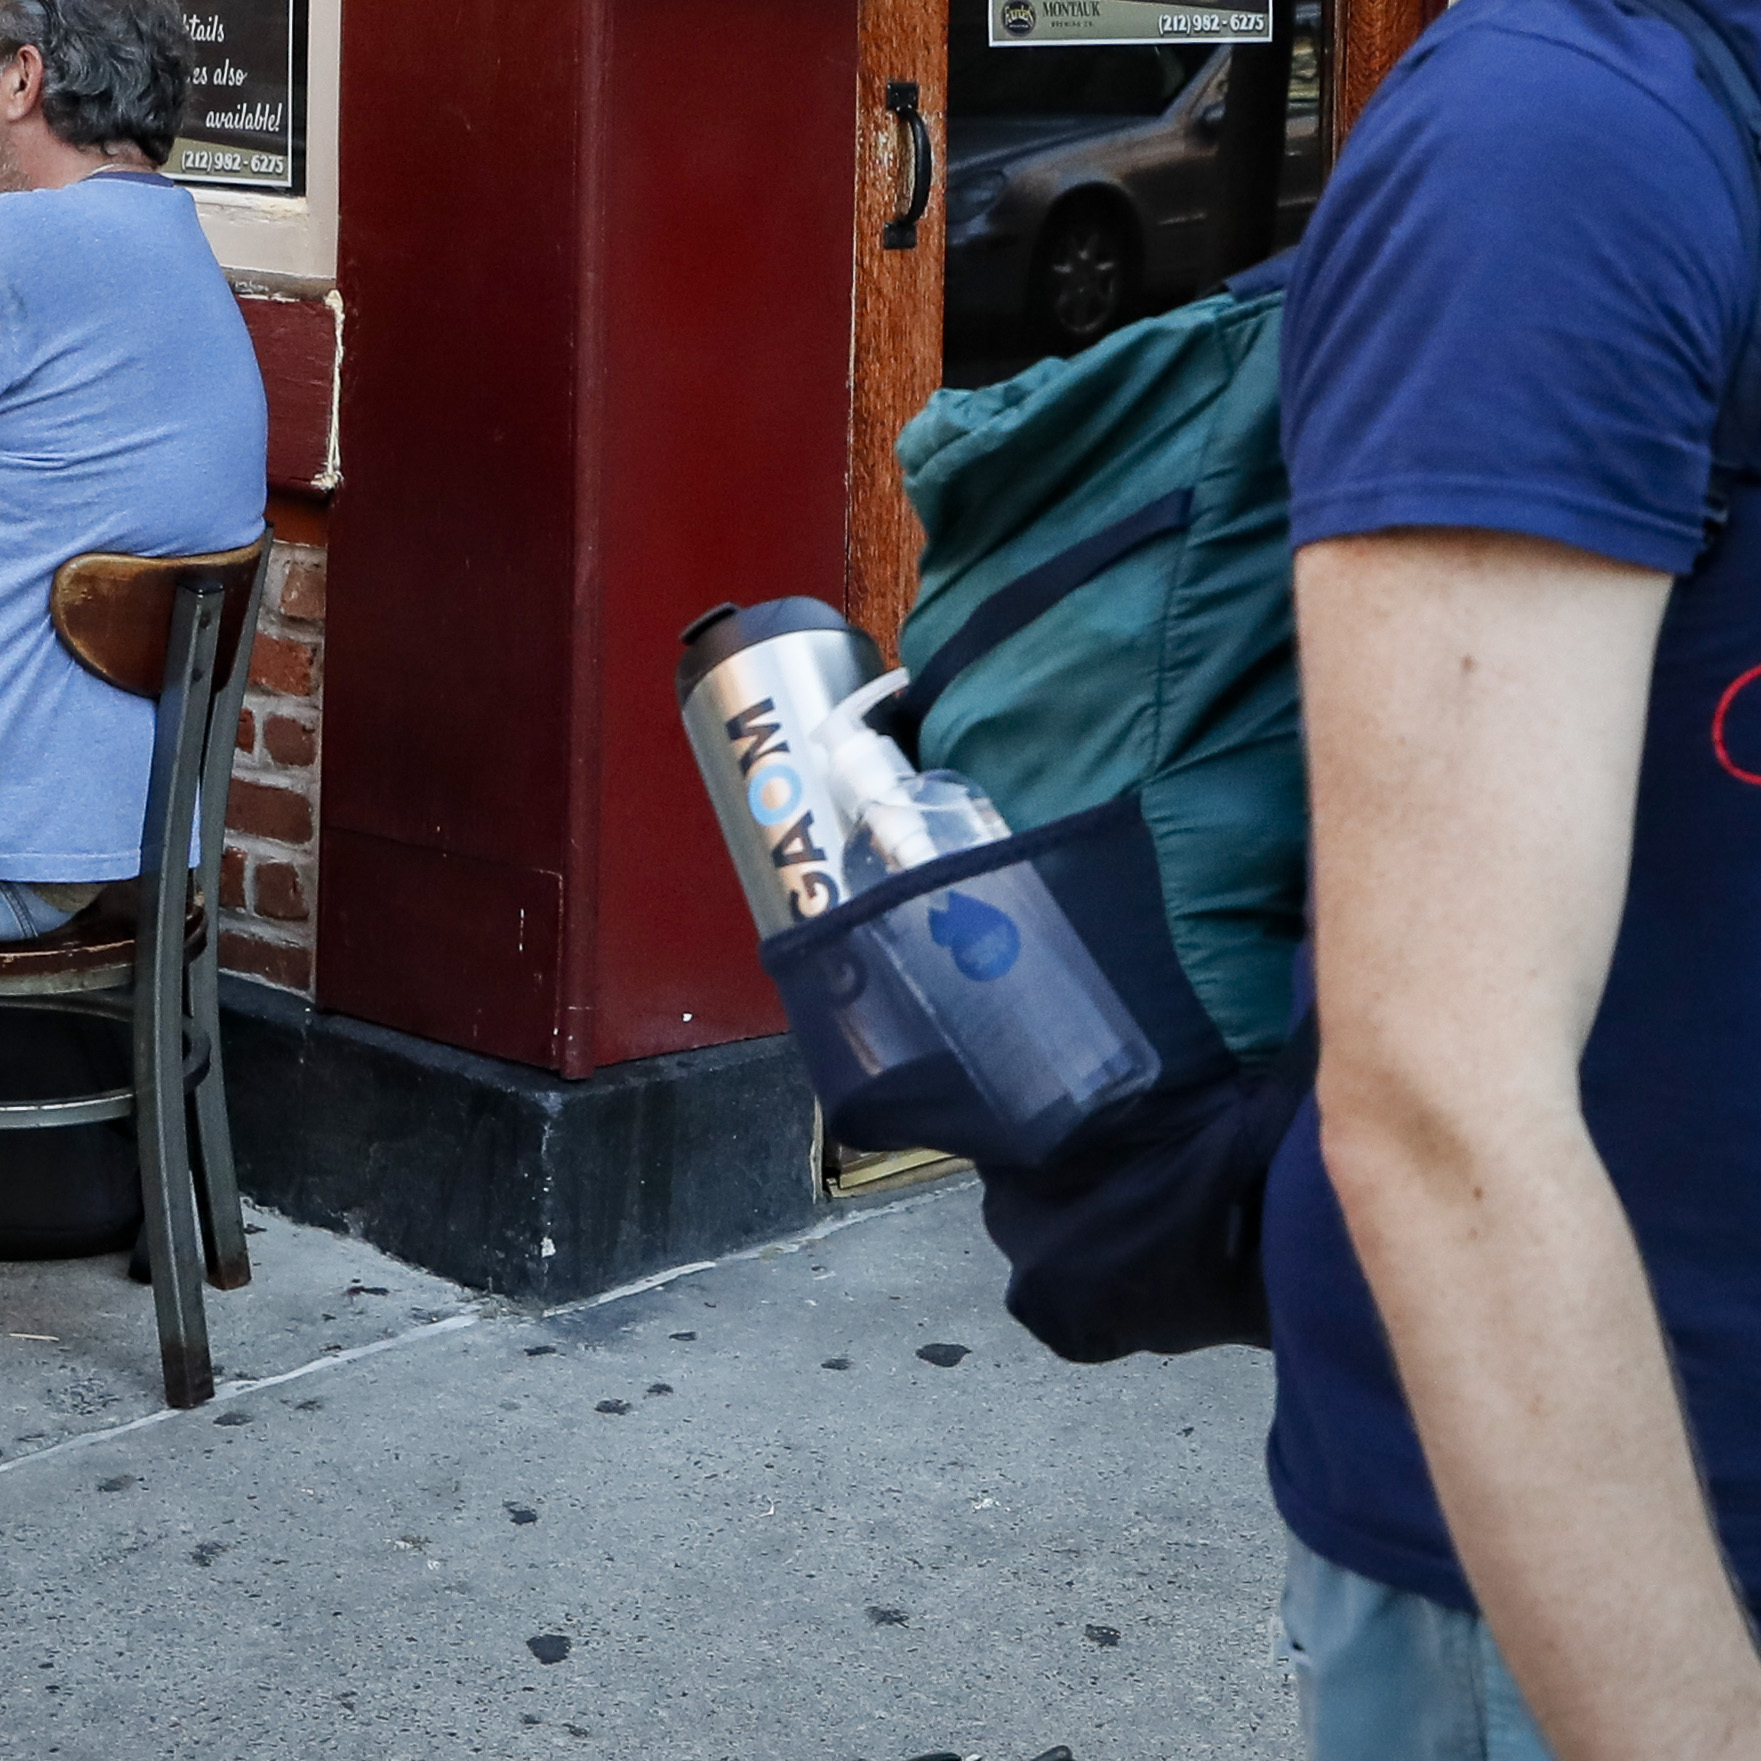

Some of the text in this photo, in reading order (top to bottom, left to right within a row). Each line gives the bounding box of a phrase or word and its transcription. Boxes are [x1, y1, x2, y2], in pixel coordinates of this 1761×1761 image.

[1042, 1, 1101, 18] MONTAUK
[183, 13, 225, 43] tails
[213, 59, 248, 87] also
[205, 103, 283, 132] available!
